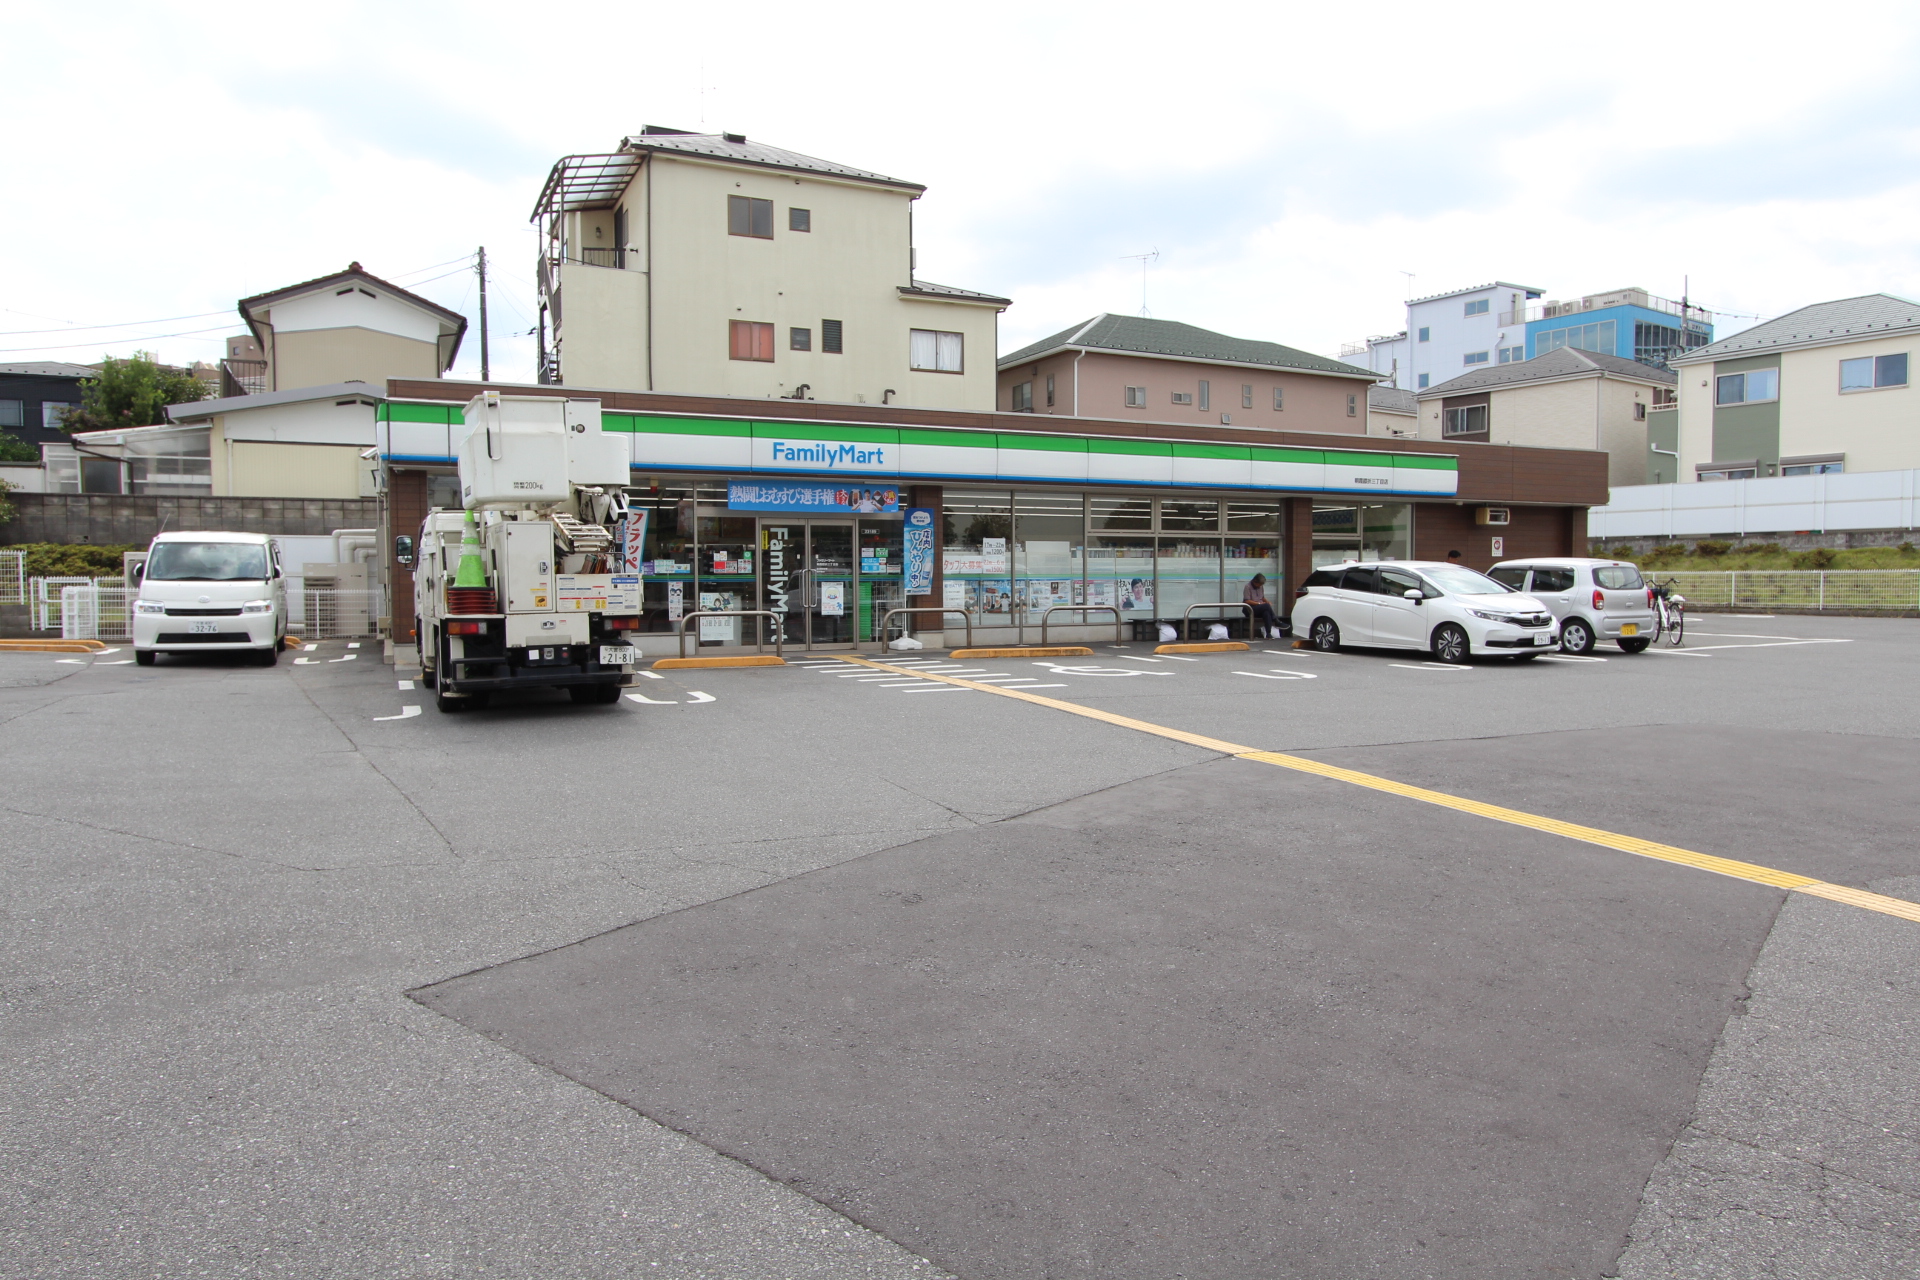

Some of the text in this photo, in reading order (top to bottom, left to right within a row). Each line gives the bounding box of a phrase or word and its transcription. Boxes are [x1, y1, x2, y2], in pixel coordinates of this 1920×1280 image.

[772, 441, 884, 467] FamilyMart
[625, 512, 644, 569] フラッペ
[923, 530, 931, 547] 店内
[767, 527, 789, 643] FamilyMart
[607, 653, 632, 662] 21-81
